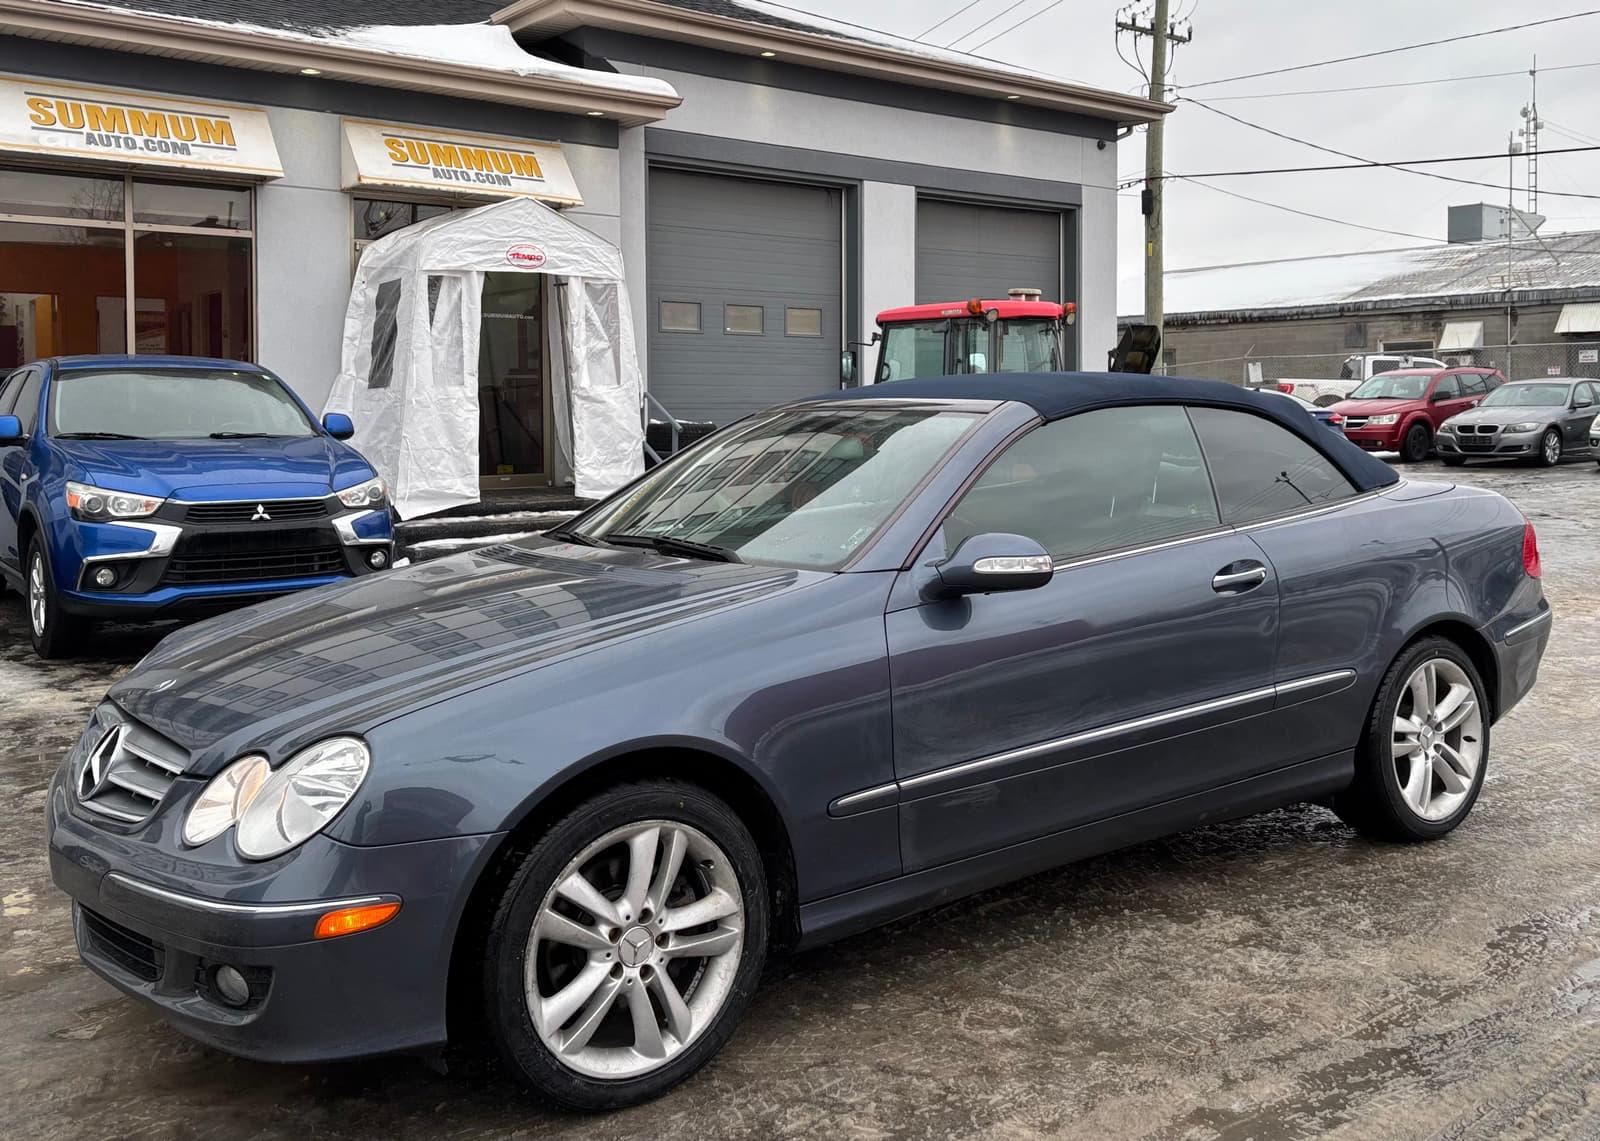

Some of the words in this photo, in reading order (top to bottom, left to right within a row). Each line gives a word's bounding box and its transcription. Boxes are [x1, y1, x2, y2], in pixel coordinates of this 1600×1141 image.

[27, 97, 236, 146] SUMMUM
[85, 132, 191, 156] AUTO.COM
[384, 138, 543, 178] SUMMUM
[432, 167, 512, 187] AUTO.COM
[509, 252, 543, 261] TEMPO
